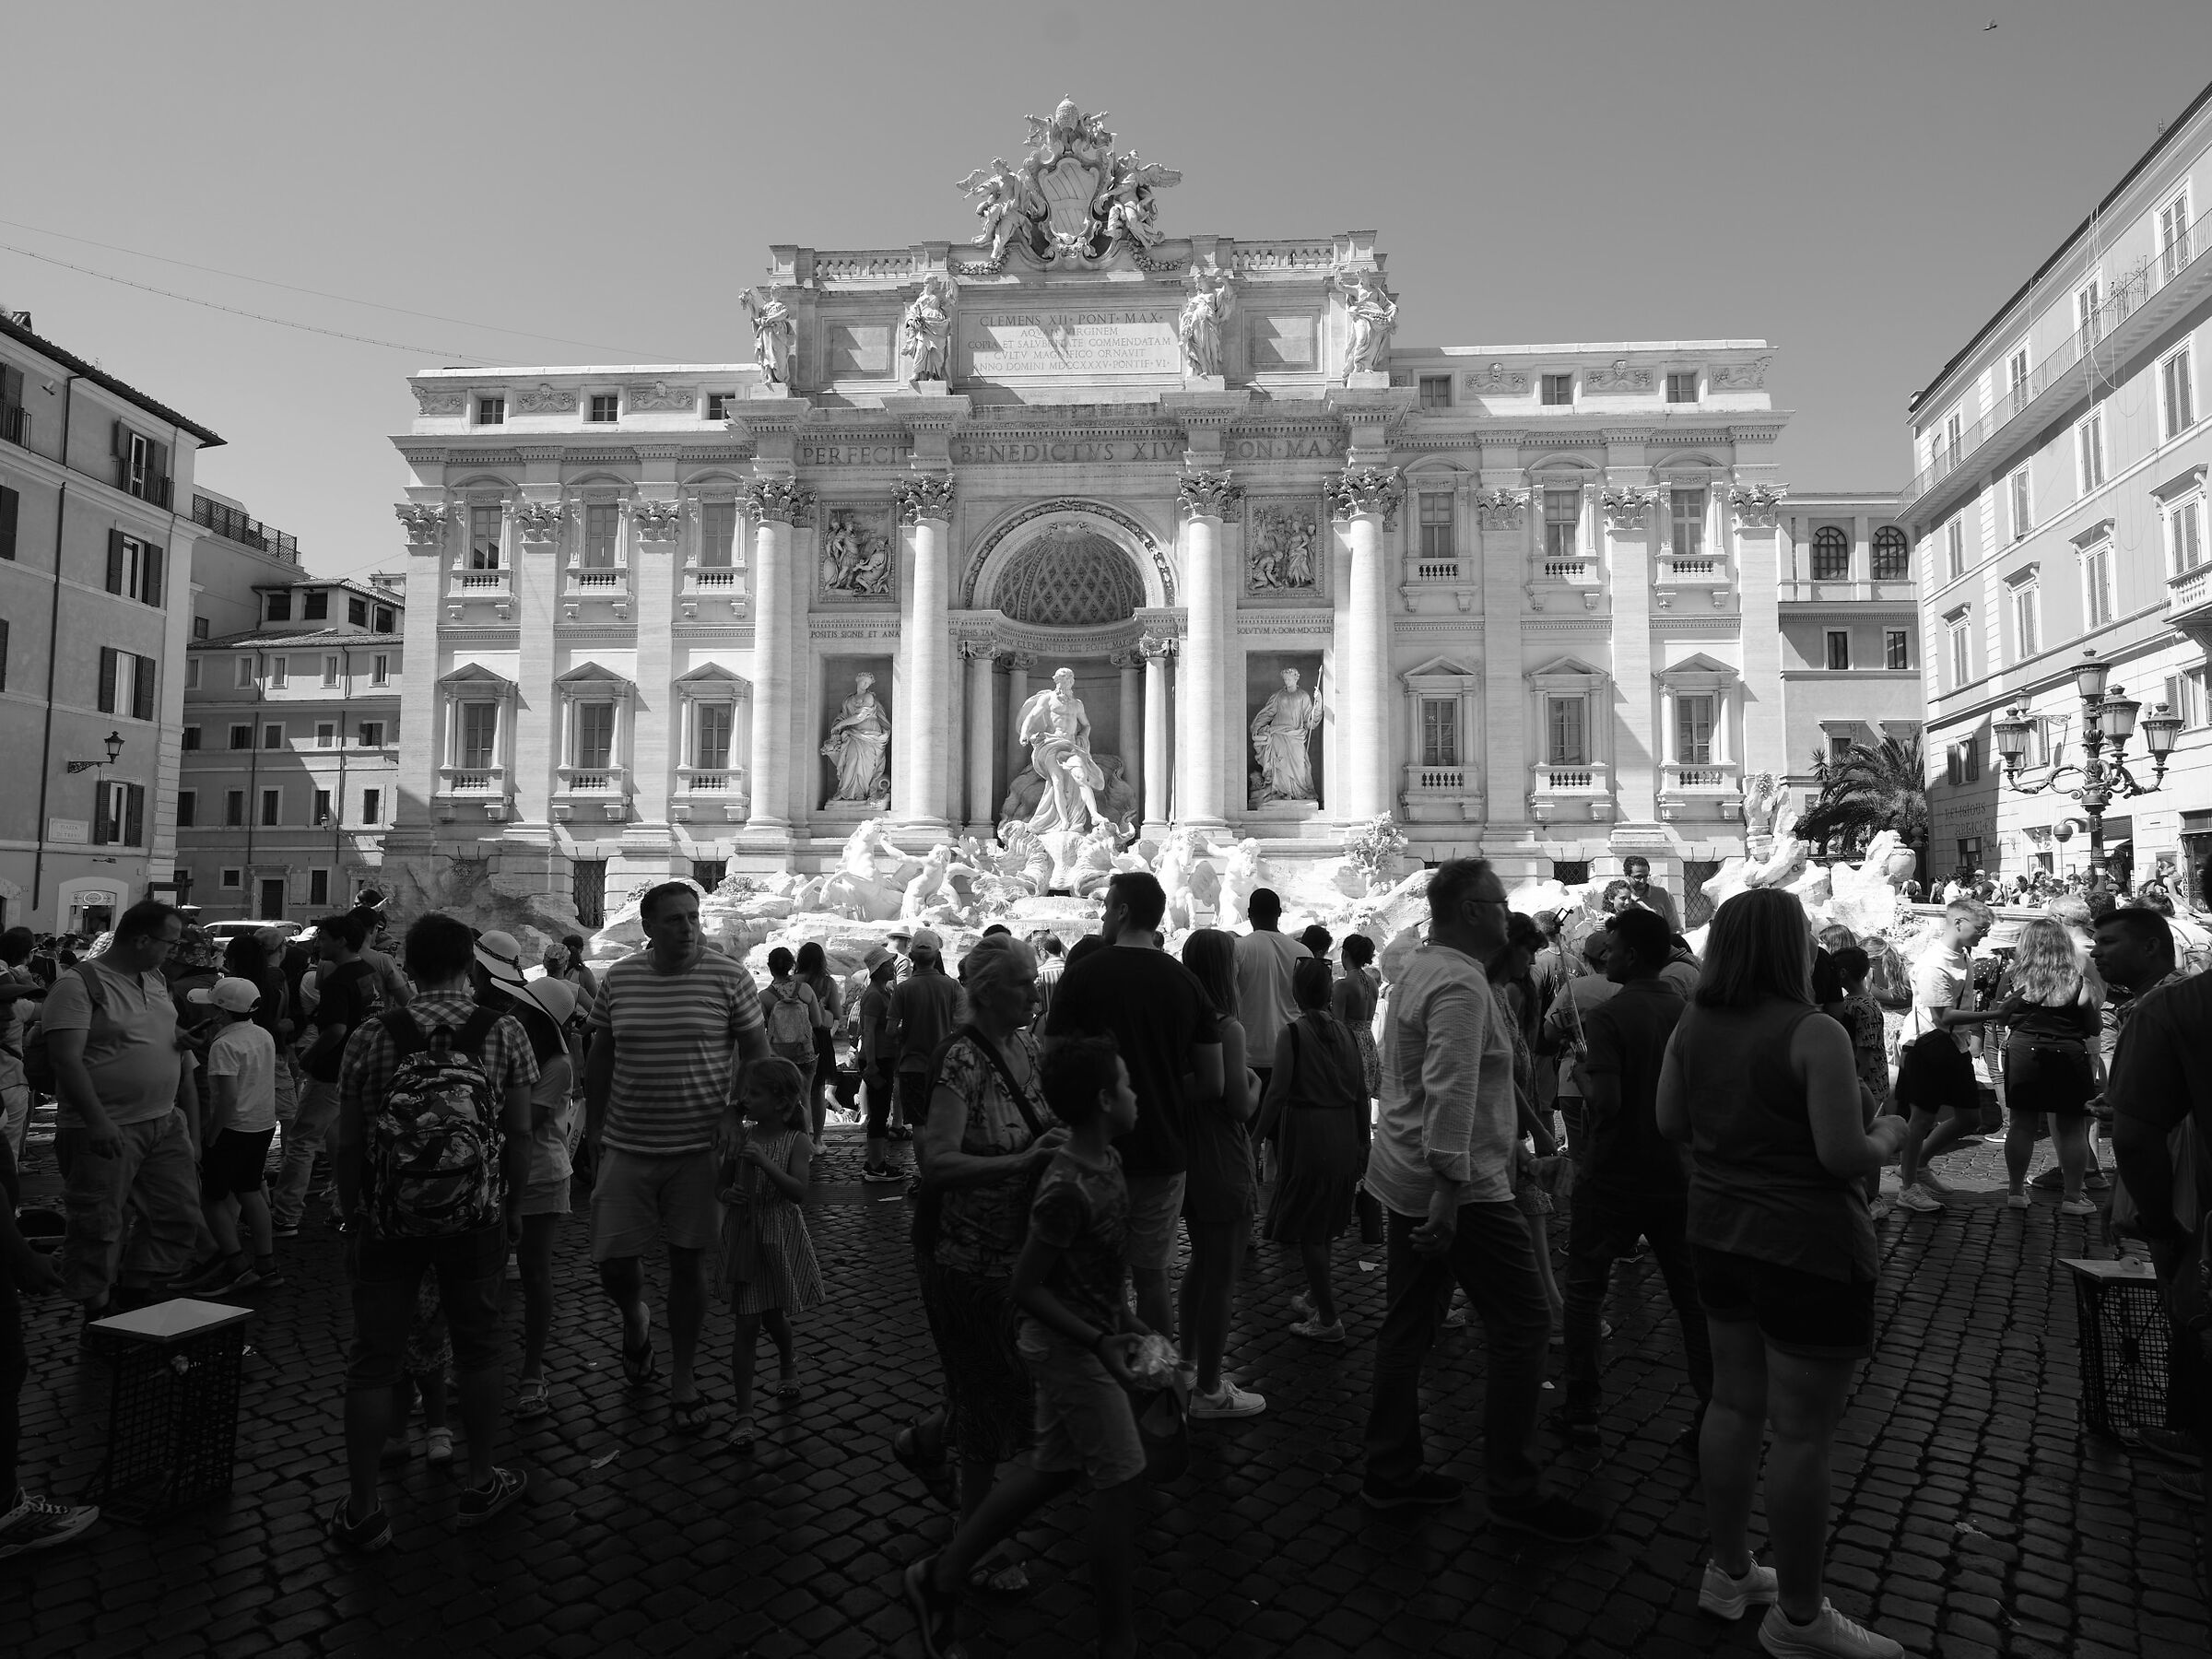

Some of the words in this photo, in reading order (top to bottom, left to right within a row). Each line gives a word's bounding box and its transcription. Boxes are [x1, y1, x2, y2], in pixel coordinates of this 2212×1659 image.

[980, 315, 1041, 326] CLEMENS
[1003, 339, 1014, 348] ET
[1088, 337, 1171, 347] COMMENDATAM
[1098, 348, 1146, 358] ORNAVIT
[1006, 361, 1045, 371] DOMINI
[802, 446, 912, 465] PERFECIT
[960, 442, 1114, 463] BENEDICTVS
[810, 630, 838, 639] POSITIS
[841, 630, 865, 639] SIGNIS
[1236, 627, 1270, 635] SOLVTVM
